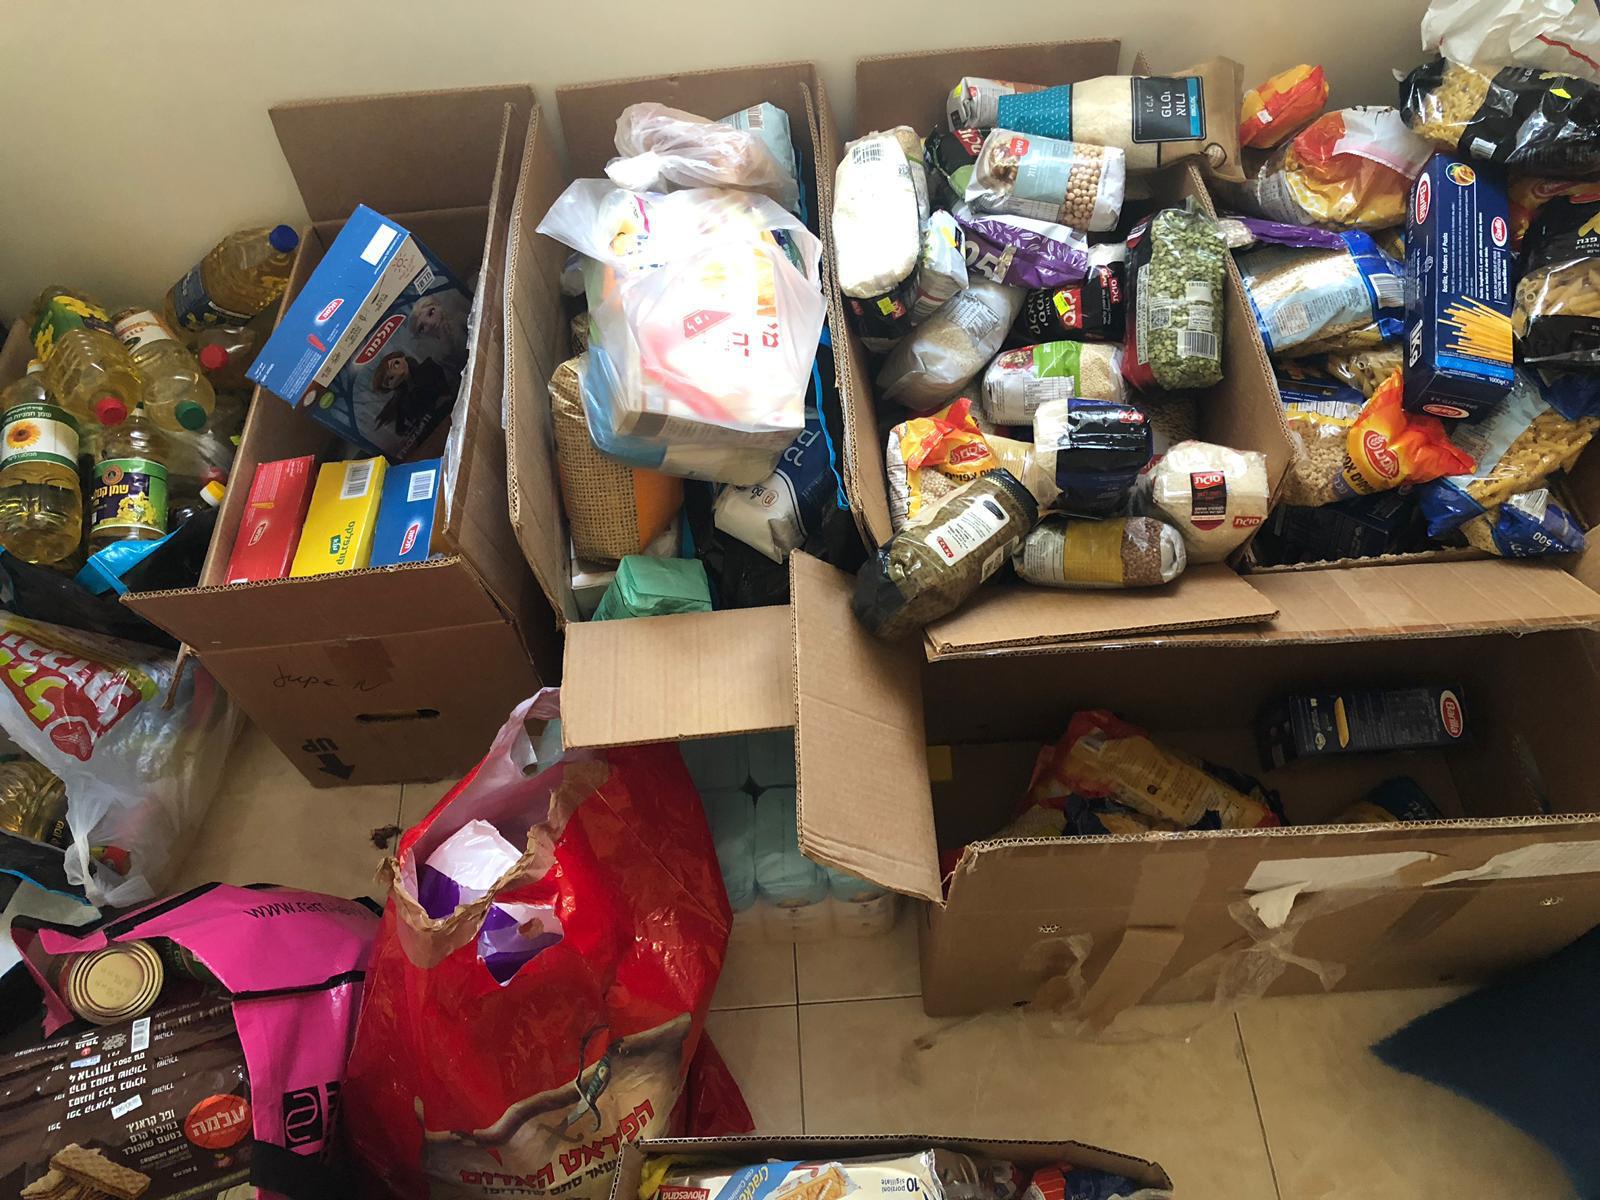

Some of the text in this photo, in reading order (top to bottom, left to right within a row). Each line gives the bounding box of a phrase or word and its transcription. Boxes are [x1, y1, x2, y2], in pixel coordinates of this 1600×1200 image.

[1160, 90, 1172, 118] פרסי
[1175, 92, 1187, 116] אורז
[1419, 185, 1427, 219] Barilla
[1441, 232, 1449, 246] Pasta
[1576, 236, 1598, 247] פנה
[1575, 244, 1600, 254] PENN
[1441, 255, 1449, 274] Masters
[364, 320, 395, 358] תלמה
[1371, 447, 1398, 480] אסם
[109, 483, 129, 495] שמן
[1193, 474, 1222, 488] סוגת
[1234, 517, 1260, 528] סוגת
[336, 520, 356, 566] קורנפלקס
[1532, 530, 1553, 547] 500
[1445, 700, 1462, 737] Barilla
[301, 737, 339, 754] UP
[68, 1073, 76, 1083] 4
[77, 1064, 112, 1081] אריזות
[69, 1064, 148, 1095] קרם בטעם שוקולד
[120, 1077, 147, 1092] במילוי
[66, 1108, 82, 1120] ופל
[158, 1108, 175, 1122] ופל
[191, 1105, 246, 1138] עלמה
[129, 1120, 179, 1144] במילוי קרם
[121, 1130, 183, 1156] בטעם שוקולד
[458, 1162, 556, 1189] האדום
[737, 1165, 769, 1200] Cracke
[881, 1177, 905, 1186] sigillate
[906, 1177, 920, 1192] 10
[550, 1176, 583, 1196] סתם
[881, 1185, 906, 1193] porzioni
